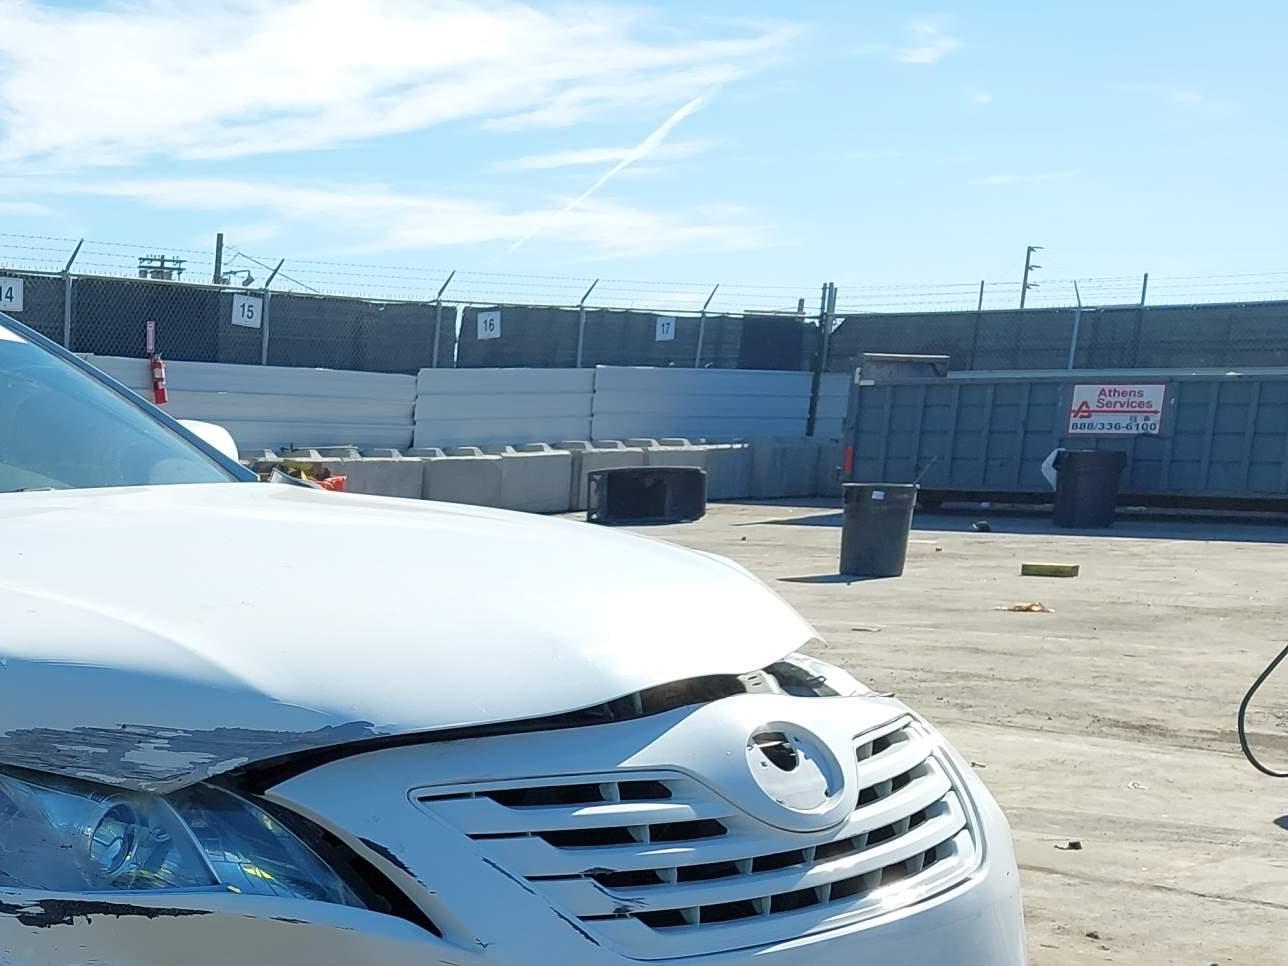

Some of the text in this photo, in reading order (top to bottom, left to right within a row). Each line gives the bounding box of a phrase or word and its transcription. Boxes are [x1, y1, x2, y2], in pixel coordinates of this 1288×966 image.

[239, 302, 255, 320] 15
[482, 318, 496, 332] 16
[660, 321, 672, 336] 17
[1097, 387, 1144, 398] Athens
[1096, 398, 1153, 409] Services
